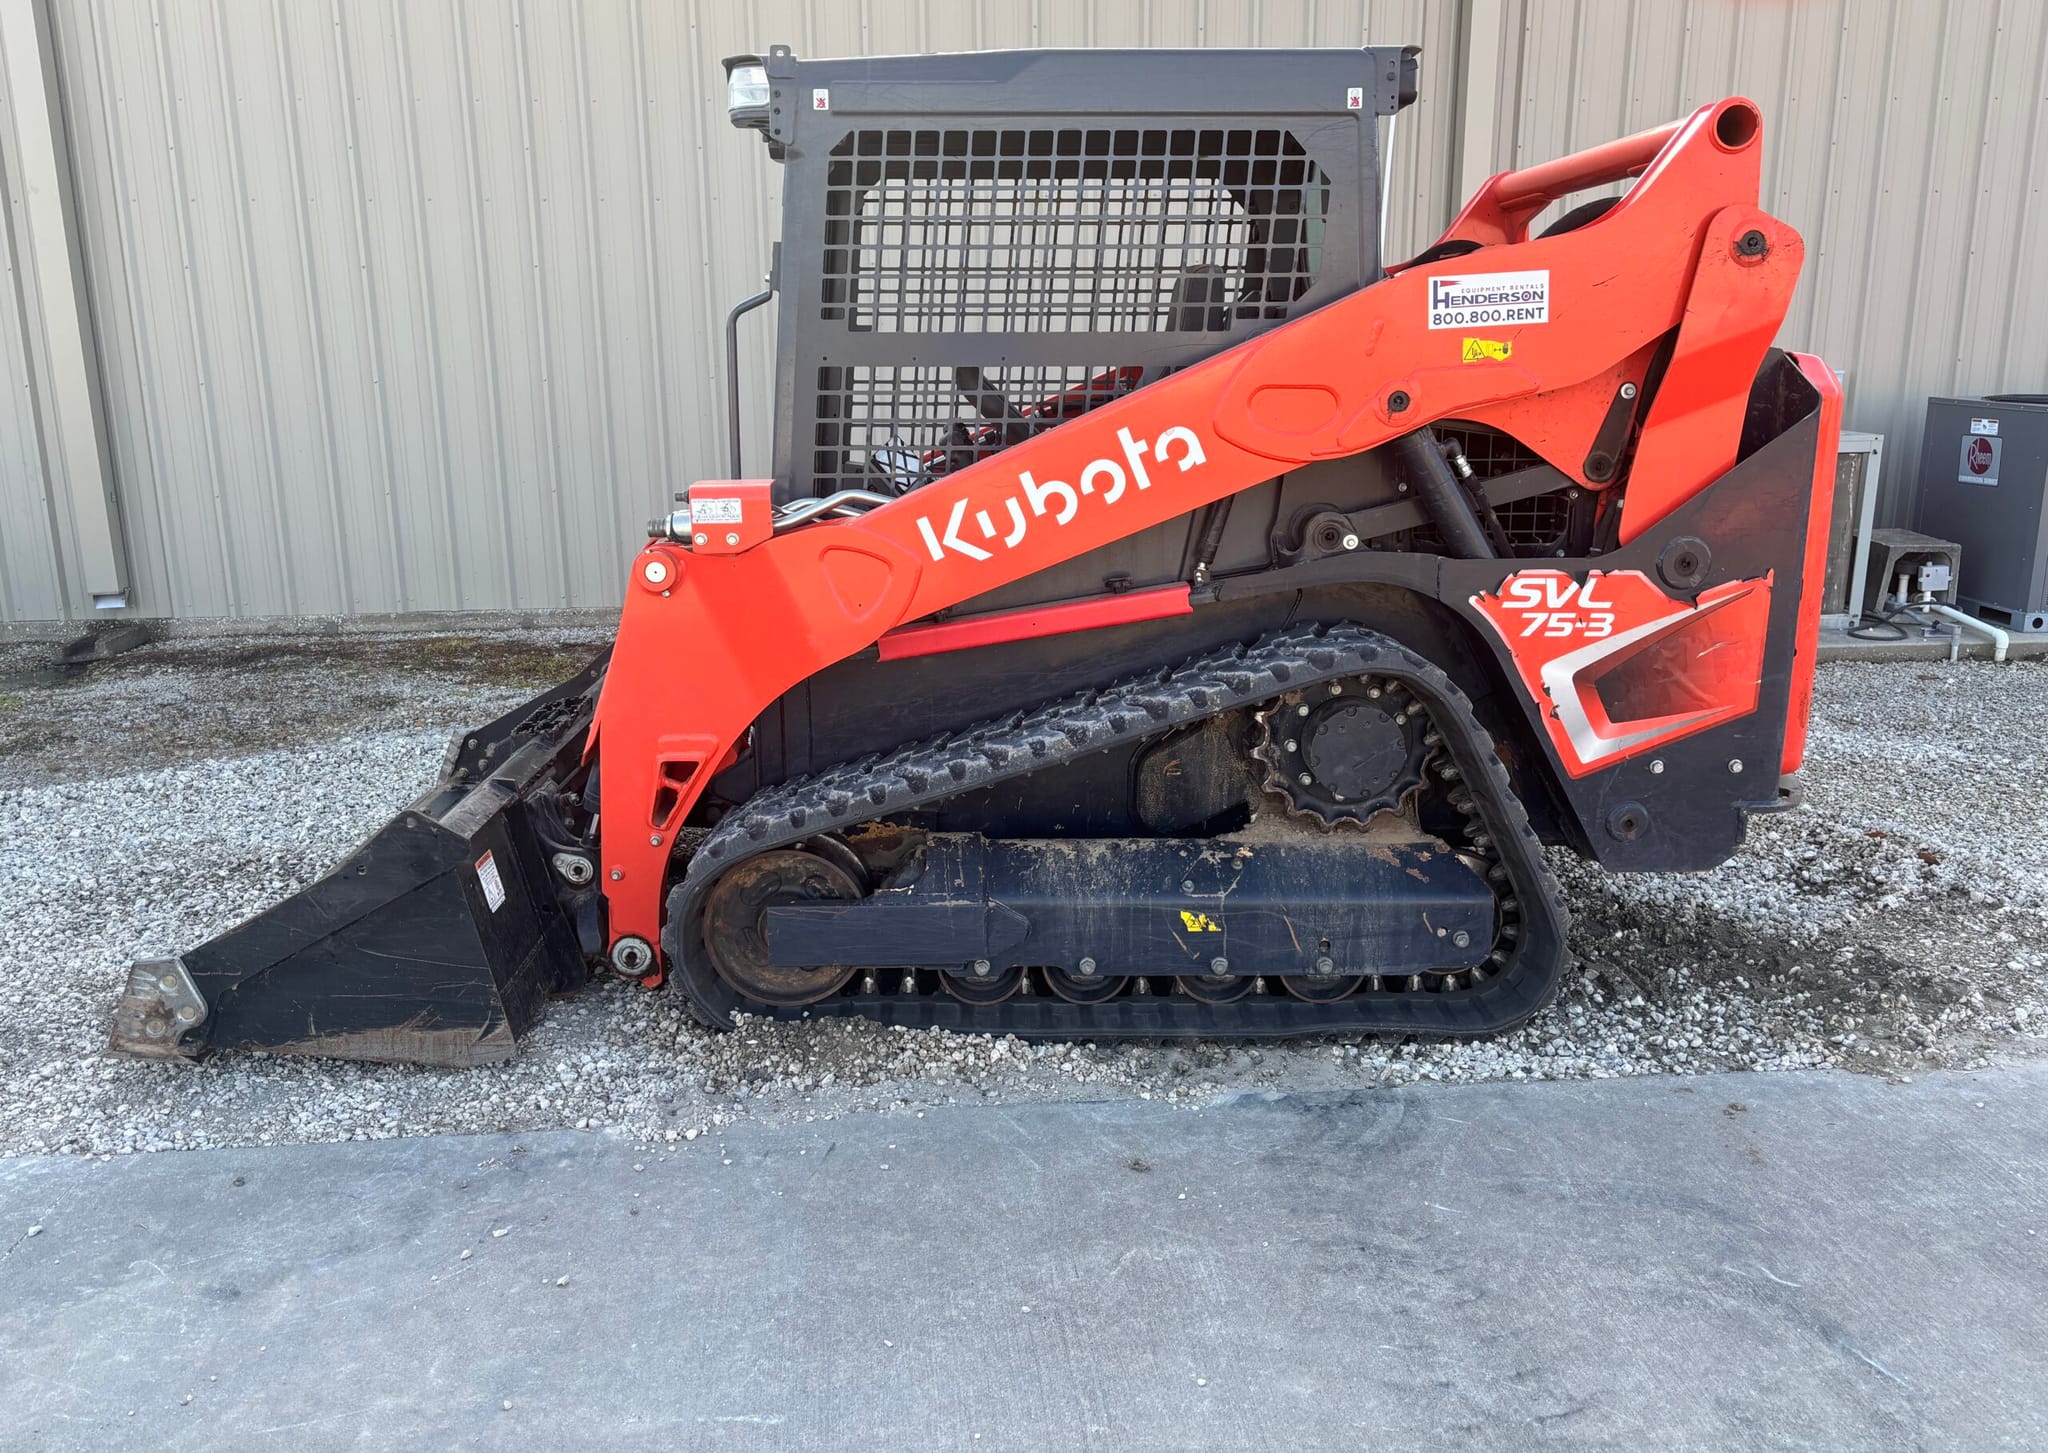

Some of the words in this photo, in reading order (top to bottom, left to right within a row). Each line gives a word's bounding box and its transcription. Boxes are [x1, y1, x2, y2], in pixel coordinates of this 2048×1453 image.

[1433, 280, 1544, 310] HENDERSON
[1461, 285, 1506, 294] EQUIPMENT
[1510, 283, 1545, 291] RENTALS
[1433, 307, 1545, 326] 800.800.RENT
[1968, 439, 1992, 470] Rheem
[916, 426, 1207, 562] Kubota
[1501, 577, 1613, 609] SVL
[1519, 612, 1615, 637] 75-3
